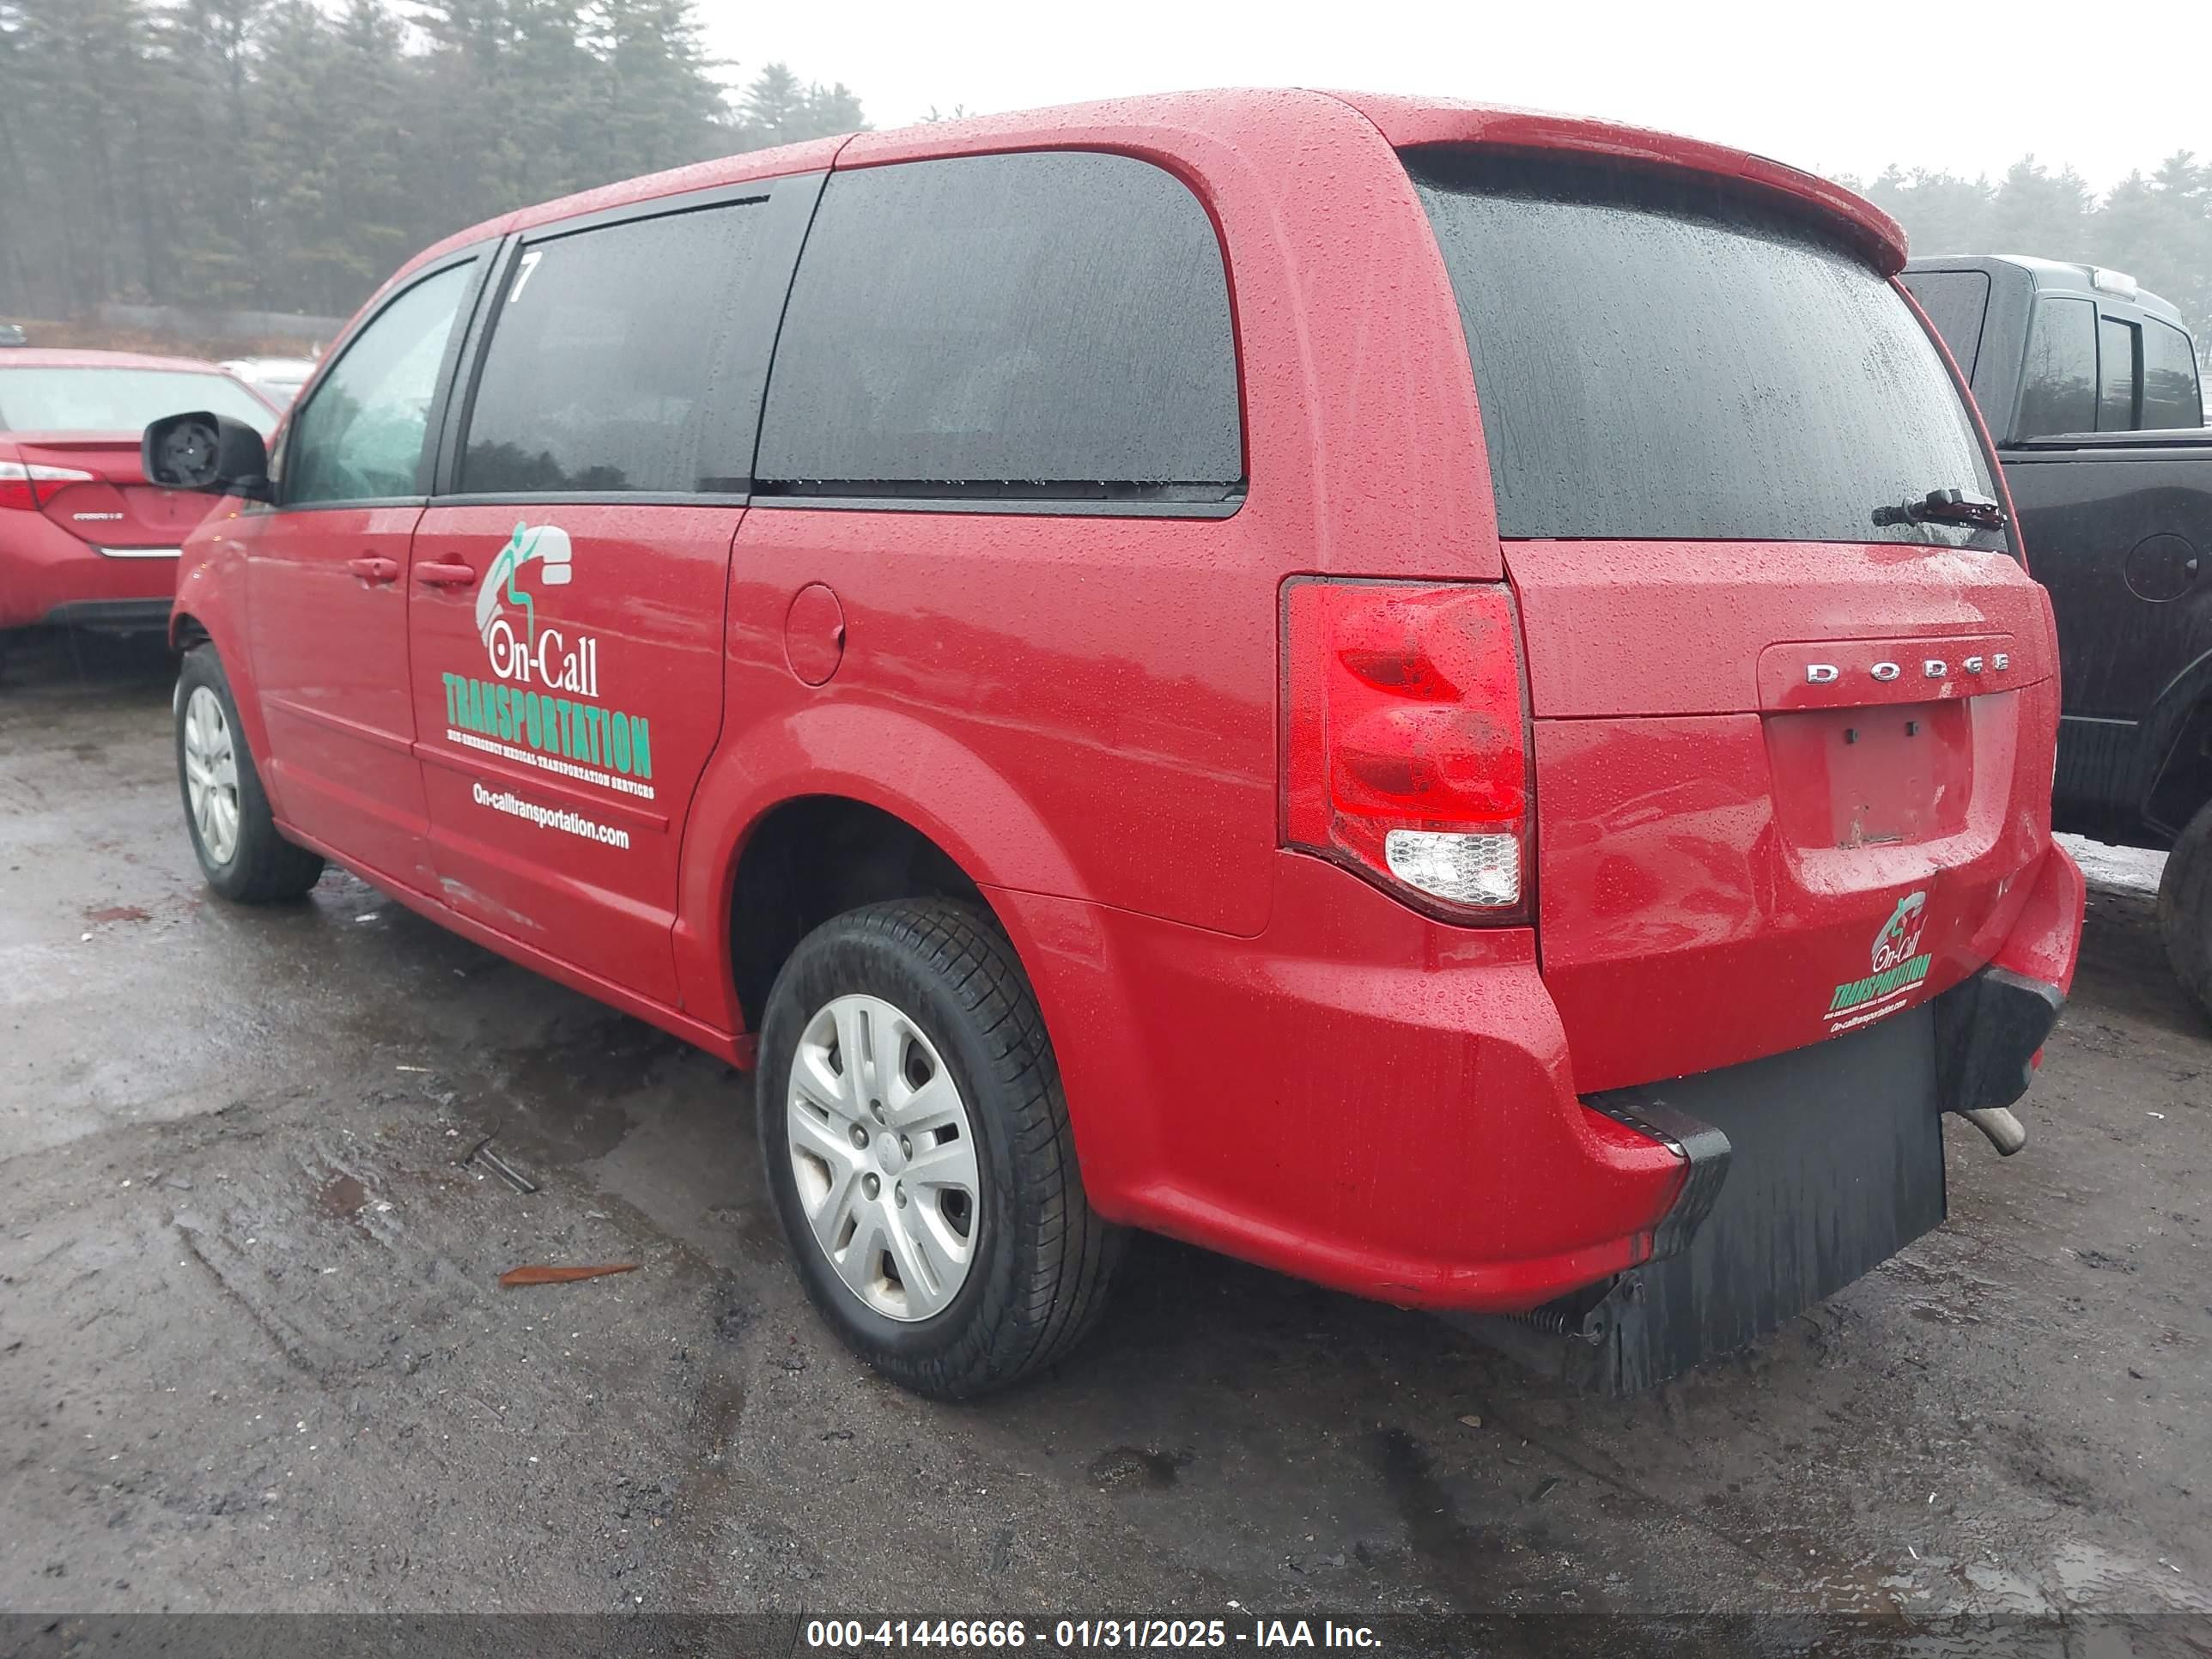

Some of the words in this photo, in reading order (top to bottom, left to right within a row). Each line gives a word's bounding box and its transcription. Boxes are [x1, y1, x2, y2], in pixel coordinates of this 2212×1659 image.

[510, 251, 543, 302] 7
[488, 619, 599, 698] On-Call
[1806, 653, 2008, 684] DODGE
[442, 672, 653, 780] TRANSPORTATION
[536, 755, 610, 787] TRANSPORTATION
[611, 775, 654, 799] SERVICES
[473, 782, 629, 849] On-calltransportation.com
[1873, 930, 1921, 973] On-Call
[1829, 953, 1932, 1012] TRANSPORTATION
